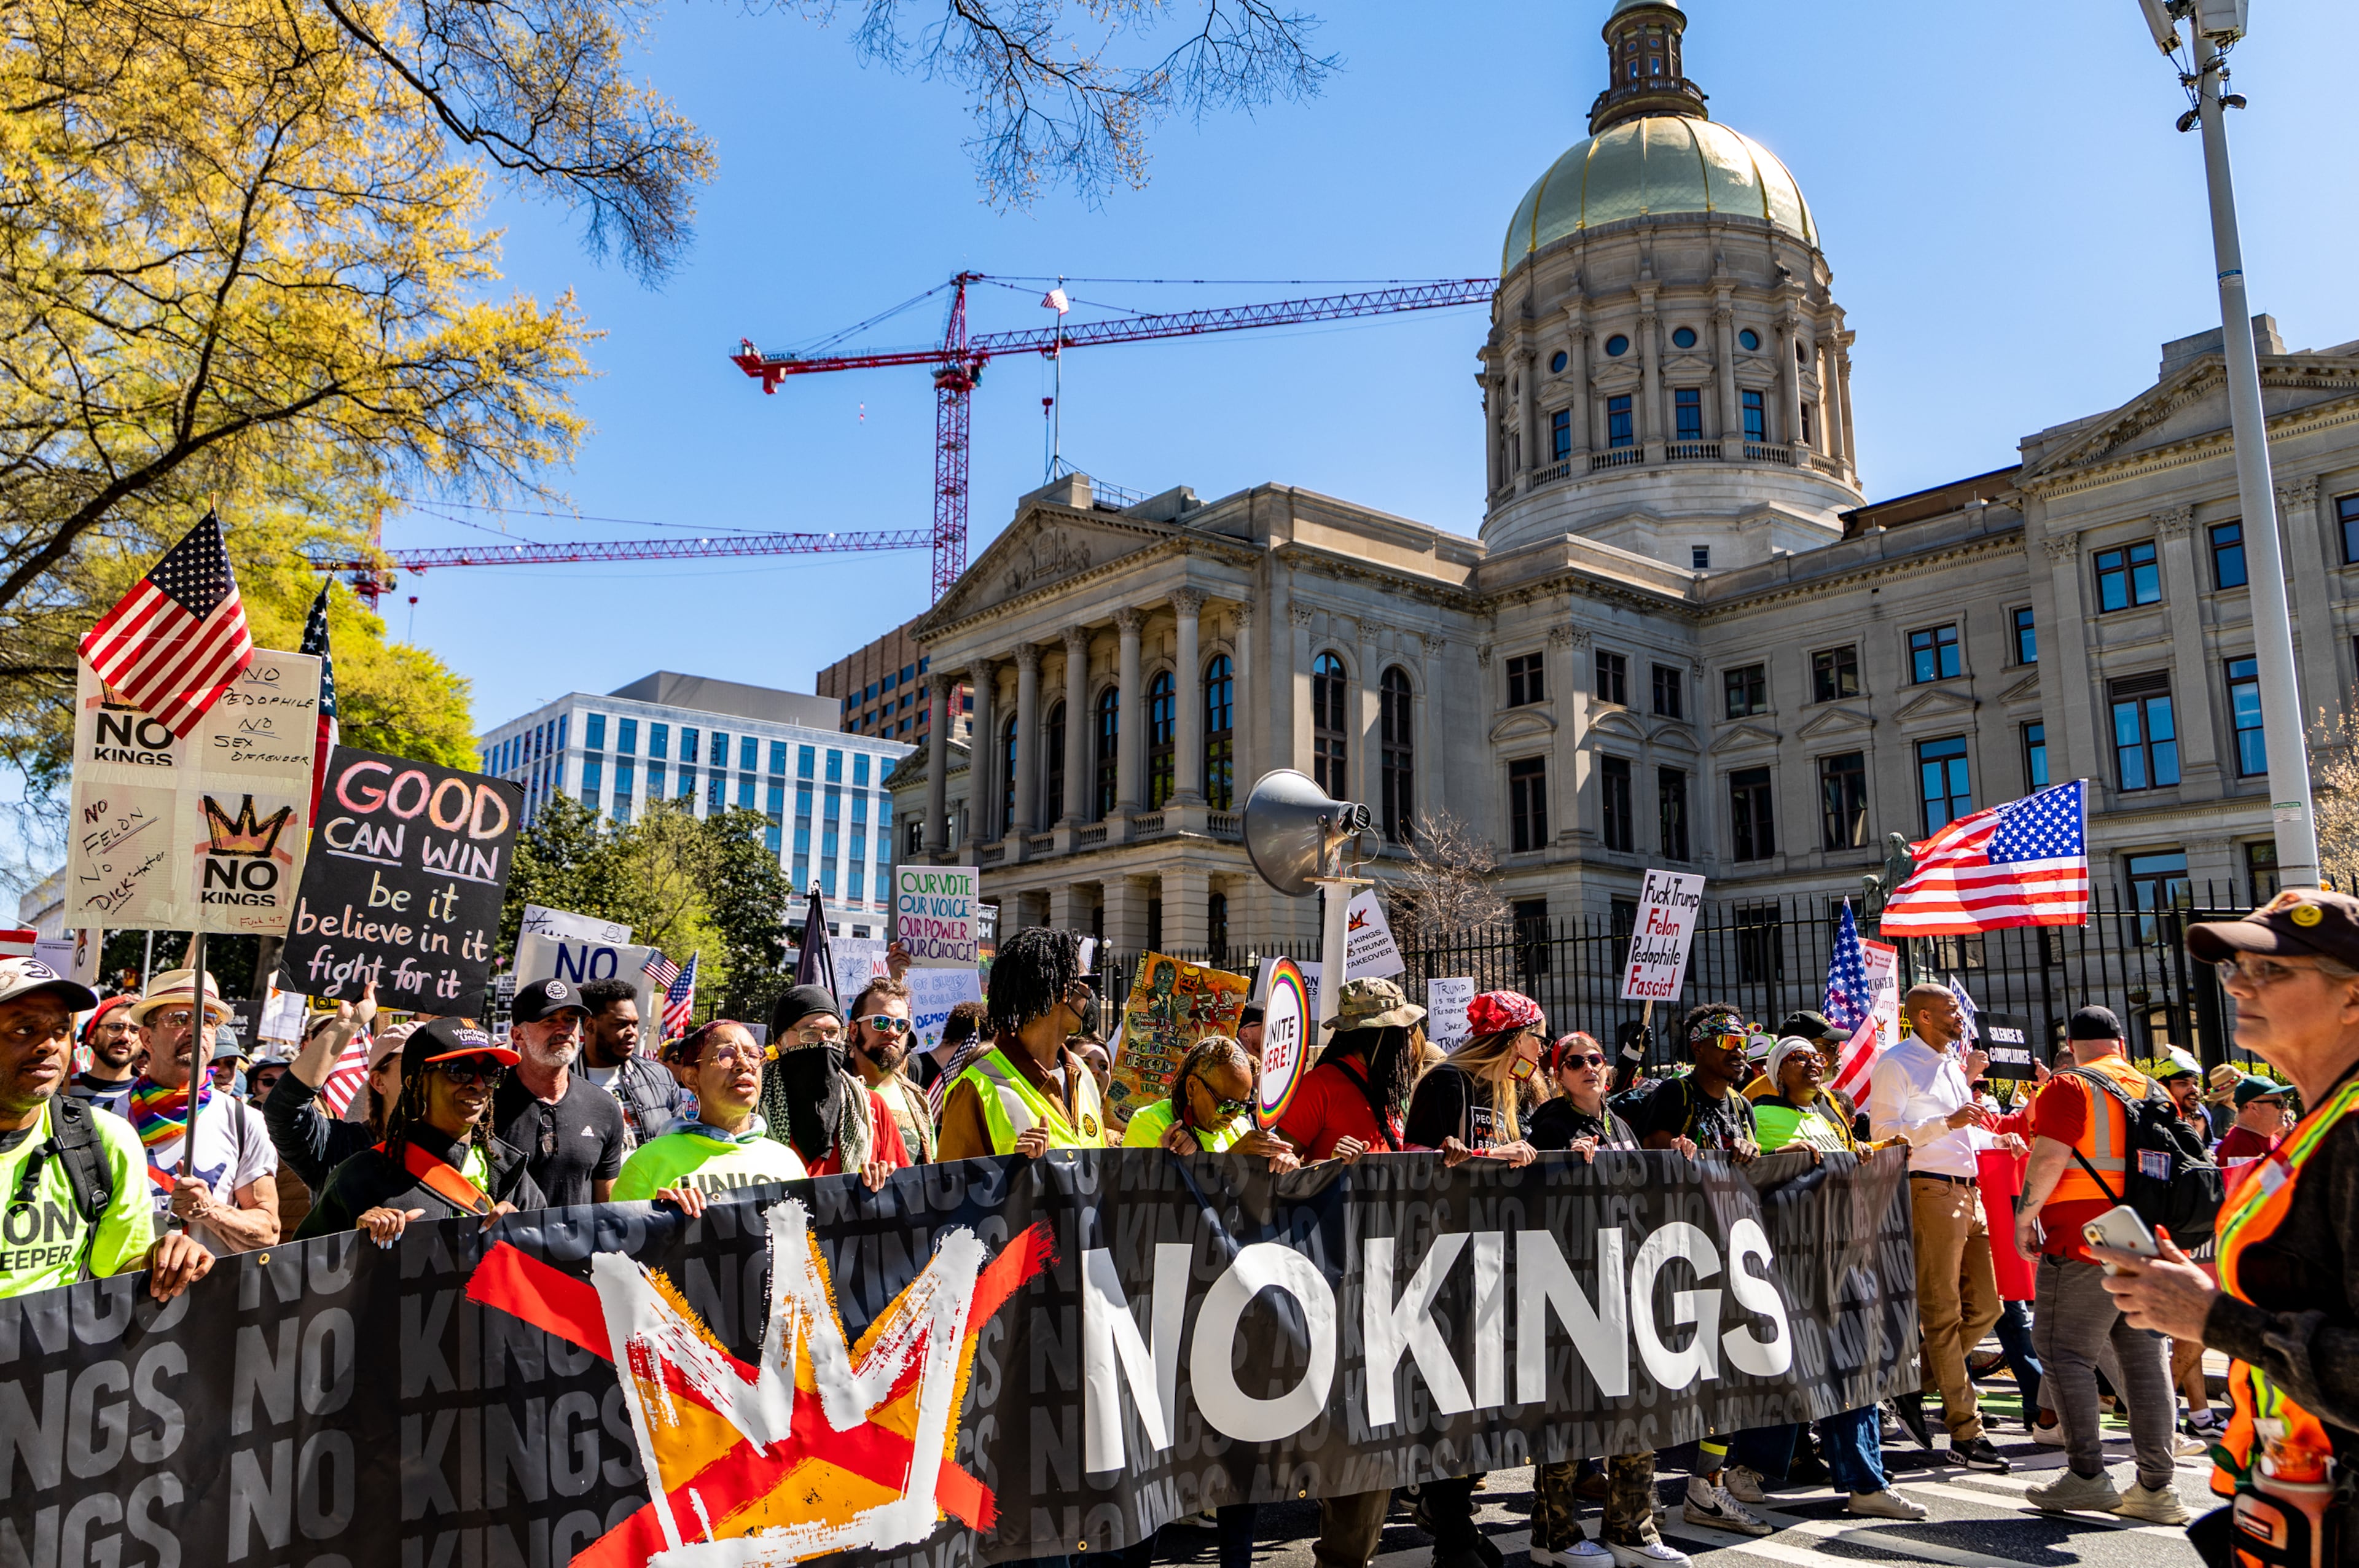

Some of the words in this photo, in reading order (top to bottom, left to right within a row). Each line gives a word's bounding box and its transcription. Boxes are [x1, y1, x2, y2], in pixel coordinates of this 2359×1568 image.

[243, 667, 280, 681] NO
[218, 687, 315, 709] PEDOPHILE
[96, 712, 174, 750] NO
[238, 717, 273, 730] NO
[214, 735, 253, 748] SEX
[94, 746, 173, 766] KINGS
[84, 799, 108, 824] NO
[336, 760, 510, 840] GOOD
[82, 806, 144, 858] FELON
[325, 816, 403, 859] CAN
[423, 836, 499, 880] WIN
[203, 858, 278, 892] NO
[901, 872, 936, 894] OUR
[938, 873, 976, 897] VOTE,
[201, 891, 276, 907] KINGS
[369, 871, 412, 911] be
[429, 884, 460, 922] it
[898, 894, 926, 915] OUR
[1643, 875, 1671, 906] Fuck
[1671, 878, 1700, 914] Trump
[297, 897, 412, 945] believe
[420, 924, 449, 954] in
[462, 929, 488, 962] it
[898, 915, 923, 938] OUR
[925, 918, 972, 942] POWER,
[1646, 908, 1680, 937] Felon
[898, 936, 926, 958] OUR
[928, 938, 978, 963] CHOICE!
[1354, 929, 1385, 945] KINGS.
[1356, 937, 1389, 953] TRUMP
[554, 942, 618, 984] NO
[1346, 946, 1395, 970] TAKEOVER.
[1630, 935, 1681, 973] Pedophile
[307, 944, 387, 997] fight
[390, 956, 432, 995] for
[437, 969, 462, 999] it
[872, 960, 888, 977] NO
[1627, 965, 1676, 997] Fascist
[1434, 981, 1466, 996] TRUMP
[1266, 1015, 1295, 1048] UNITE
[1877, 1031, 1885, 1041] NO
[1989, 1026, 2017, 1043] SILENCE
[2016, 1029, 2025, 1044] IS
[1264, 1042, 1293, 1077] HERE!
[1989, 1047, 2030, 1064] COMPLIANCE
[231, 1307, 355, 1437] NO
[1776, 1190, 1817, 1246] NO
[1791, 1316, 1826, 1380] NO
[227, 1429, 355, 1565] NO
[1879, 1239, 1917, 1294] NO
